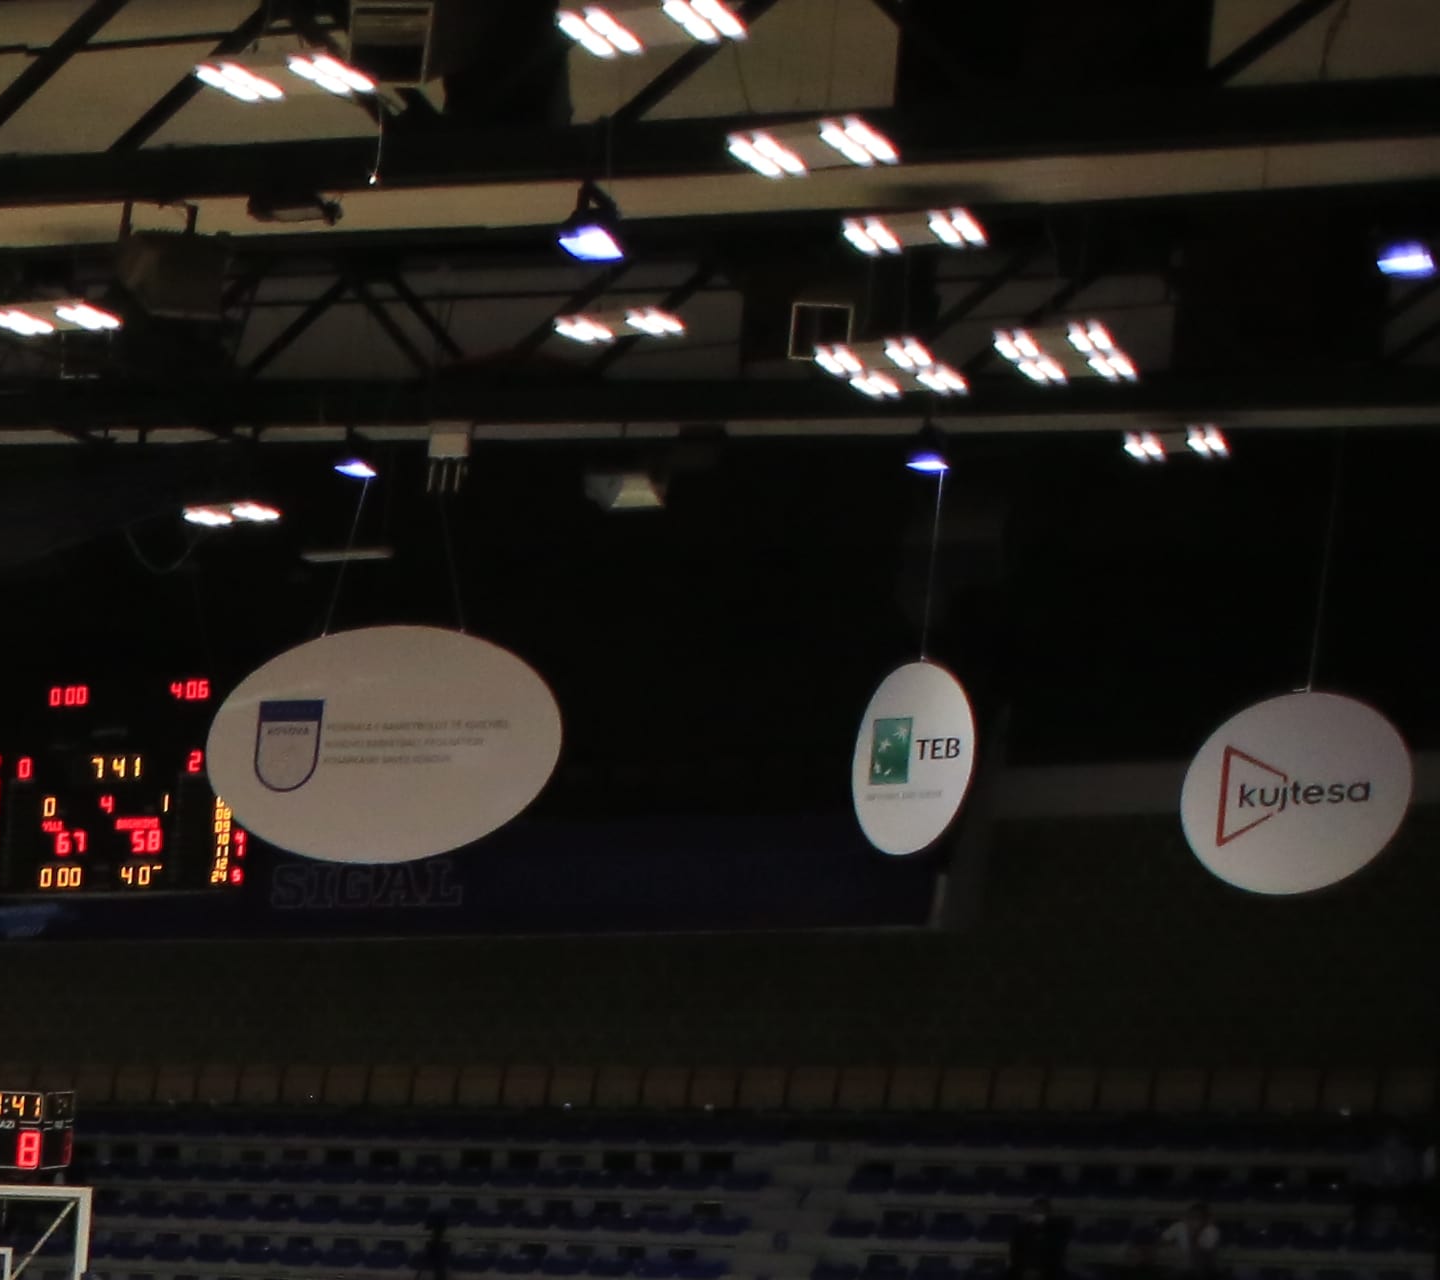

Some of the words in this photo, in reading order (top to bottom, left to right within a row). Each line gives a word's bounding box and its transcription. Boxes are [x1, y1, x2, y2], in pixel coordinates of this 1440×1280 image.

[916, 737, 961, 761] TEB
[18, 757, 31, 780] 0
[188, 750, 202, 772] 2
[101, 795, 114, 814] 4
[1238, 777, 1371, 813] kujtesa
[43, 797, 56, 817] 0
[55, 831, 86, 854] 67
[132, 829, 161, 852] 58
[17, 1130, 41, 1169] 8
